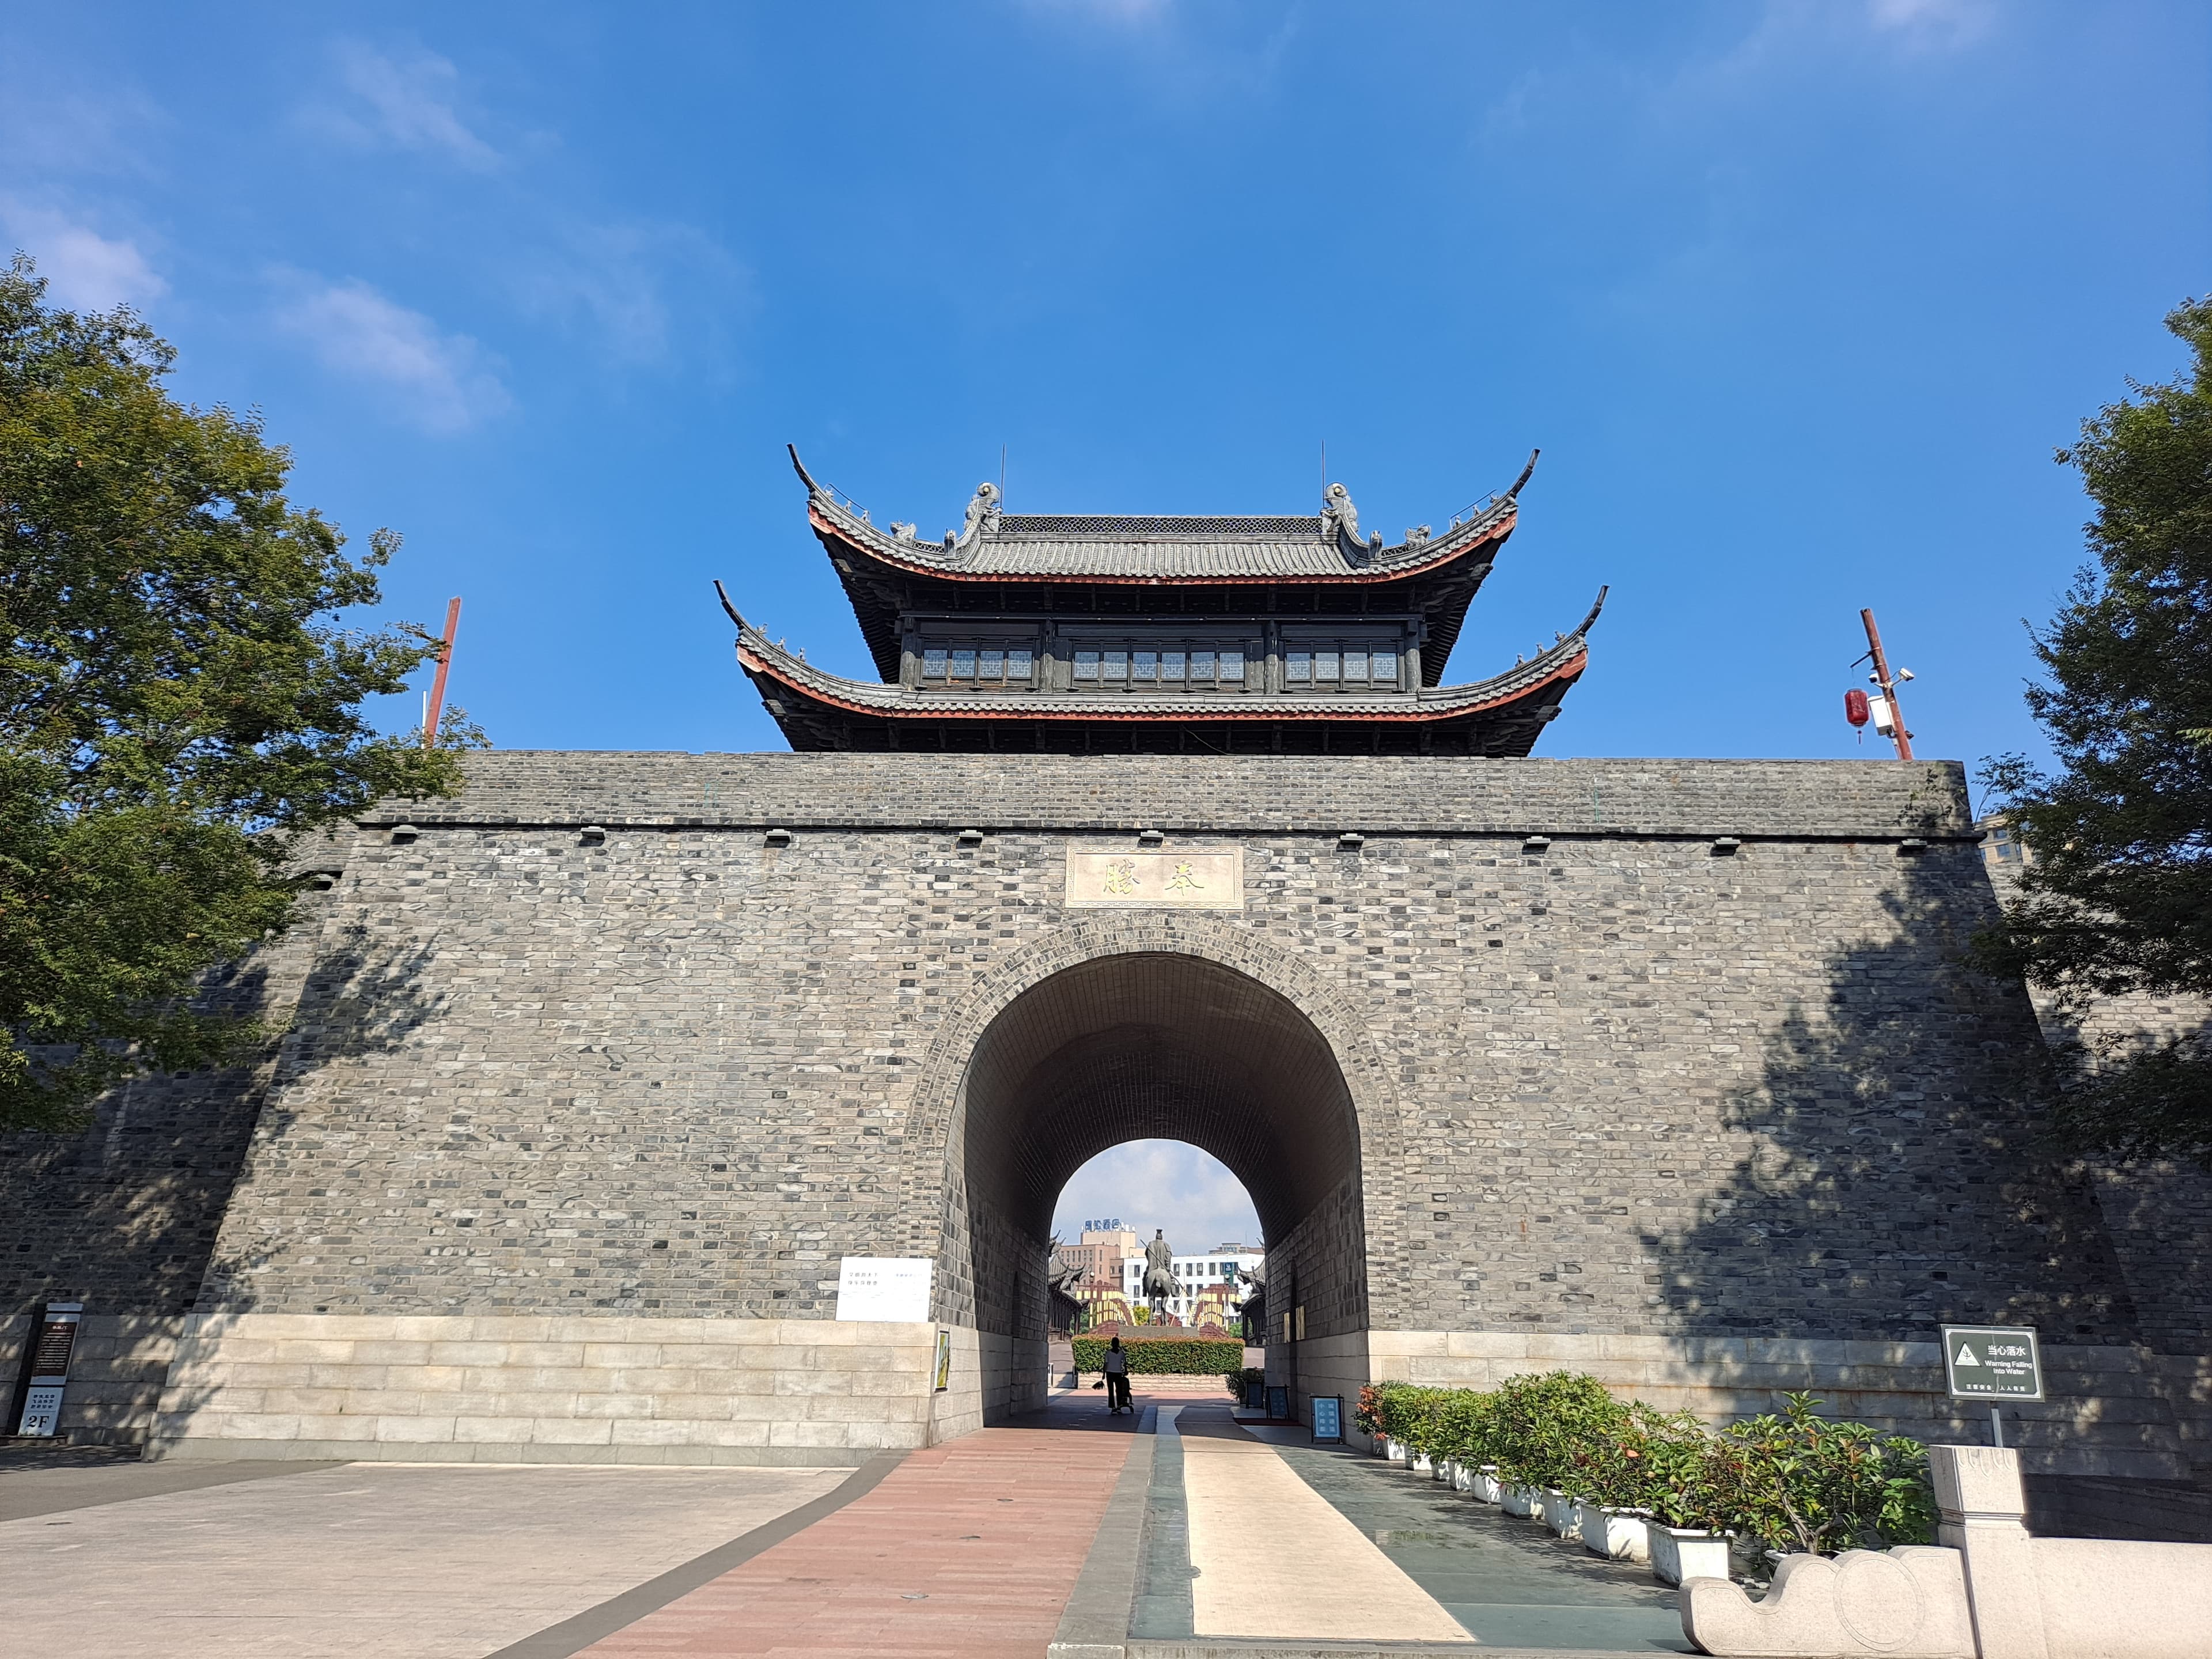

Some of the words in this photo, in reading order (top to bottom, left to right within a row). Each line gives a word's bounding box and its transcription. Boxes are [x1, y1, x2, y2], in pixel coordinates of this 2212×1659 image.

[1987, 1344, 2026, 1356] 当心落水
[1984, 1360, 2011, 1368] Warning
[27, 1415, 50, 1428] 2F
